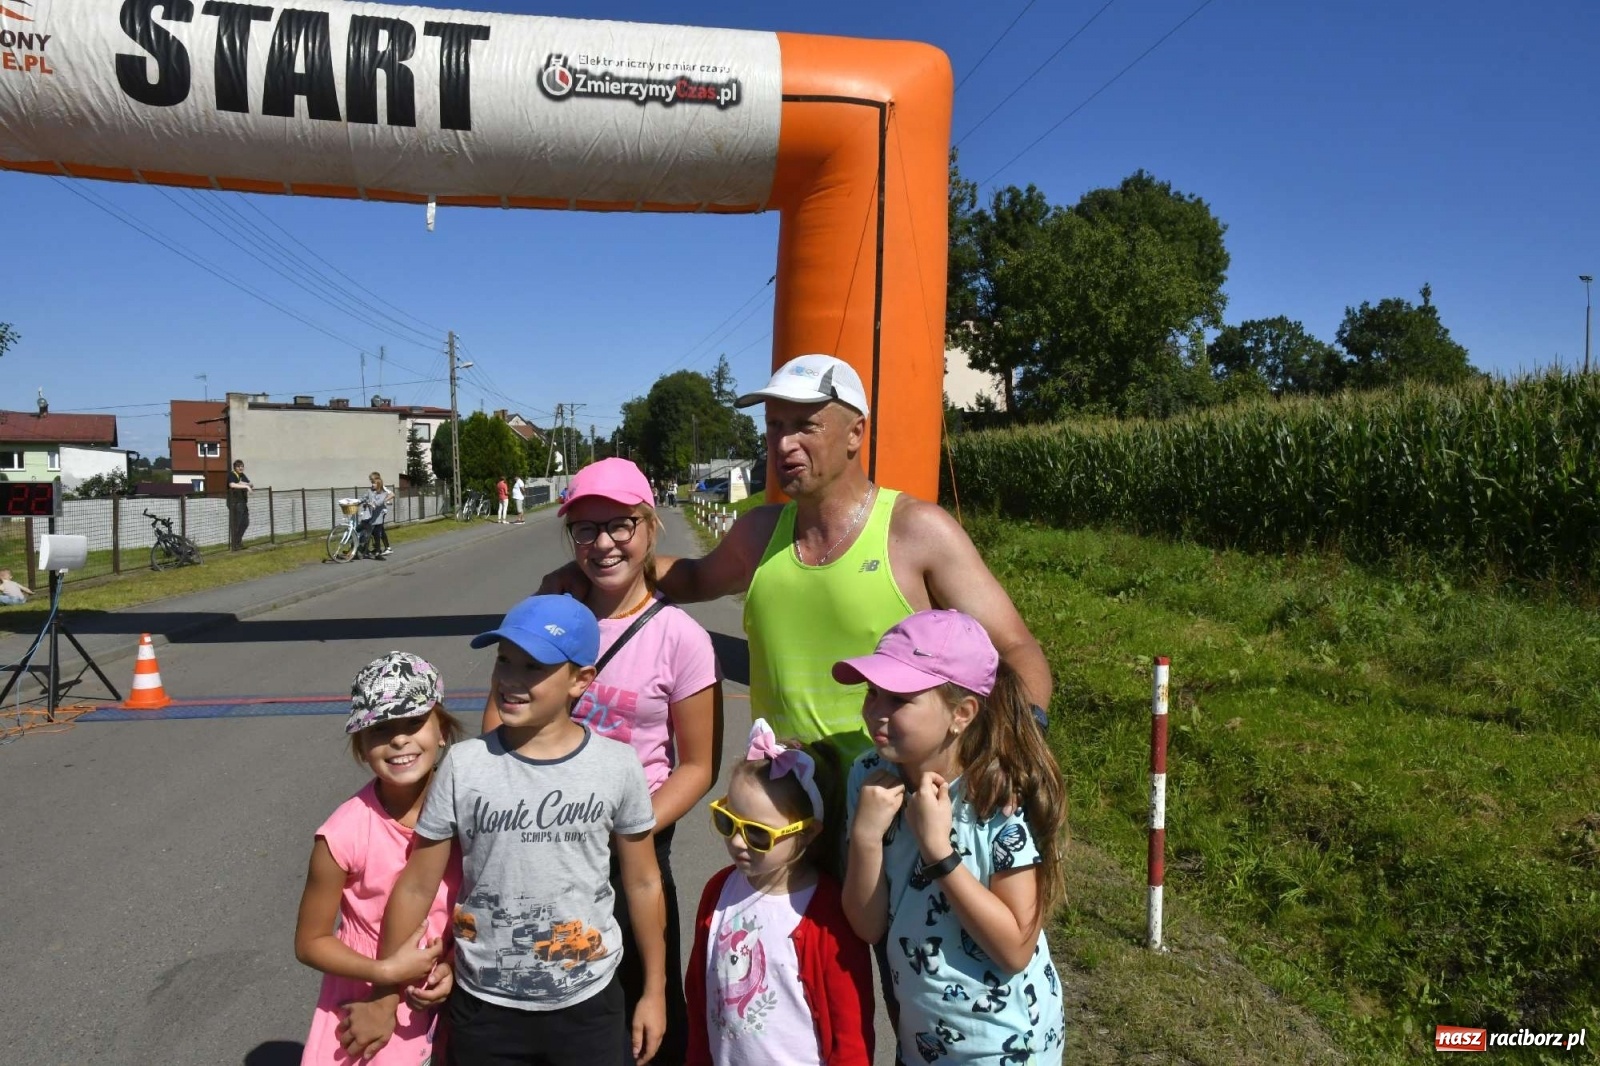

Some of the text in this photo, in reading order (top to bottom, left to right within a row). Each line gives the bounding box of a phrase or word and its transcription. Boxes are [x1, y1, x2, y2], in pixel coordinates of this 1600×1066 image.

[2, 51, 53, 75] E.PL
[115, 0, 490, 131] START
[575, 73, 737, 105] ZmierzymyCzas.pl
[8, 484, 53, 515] 22
[466, 789, 606, 839] Monte Carlo
